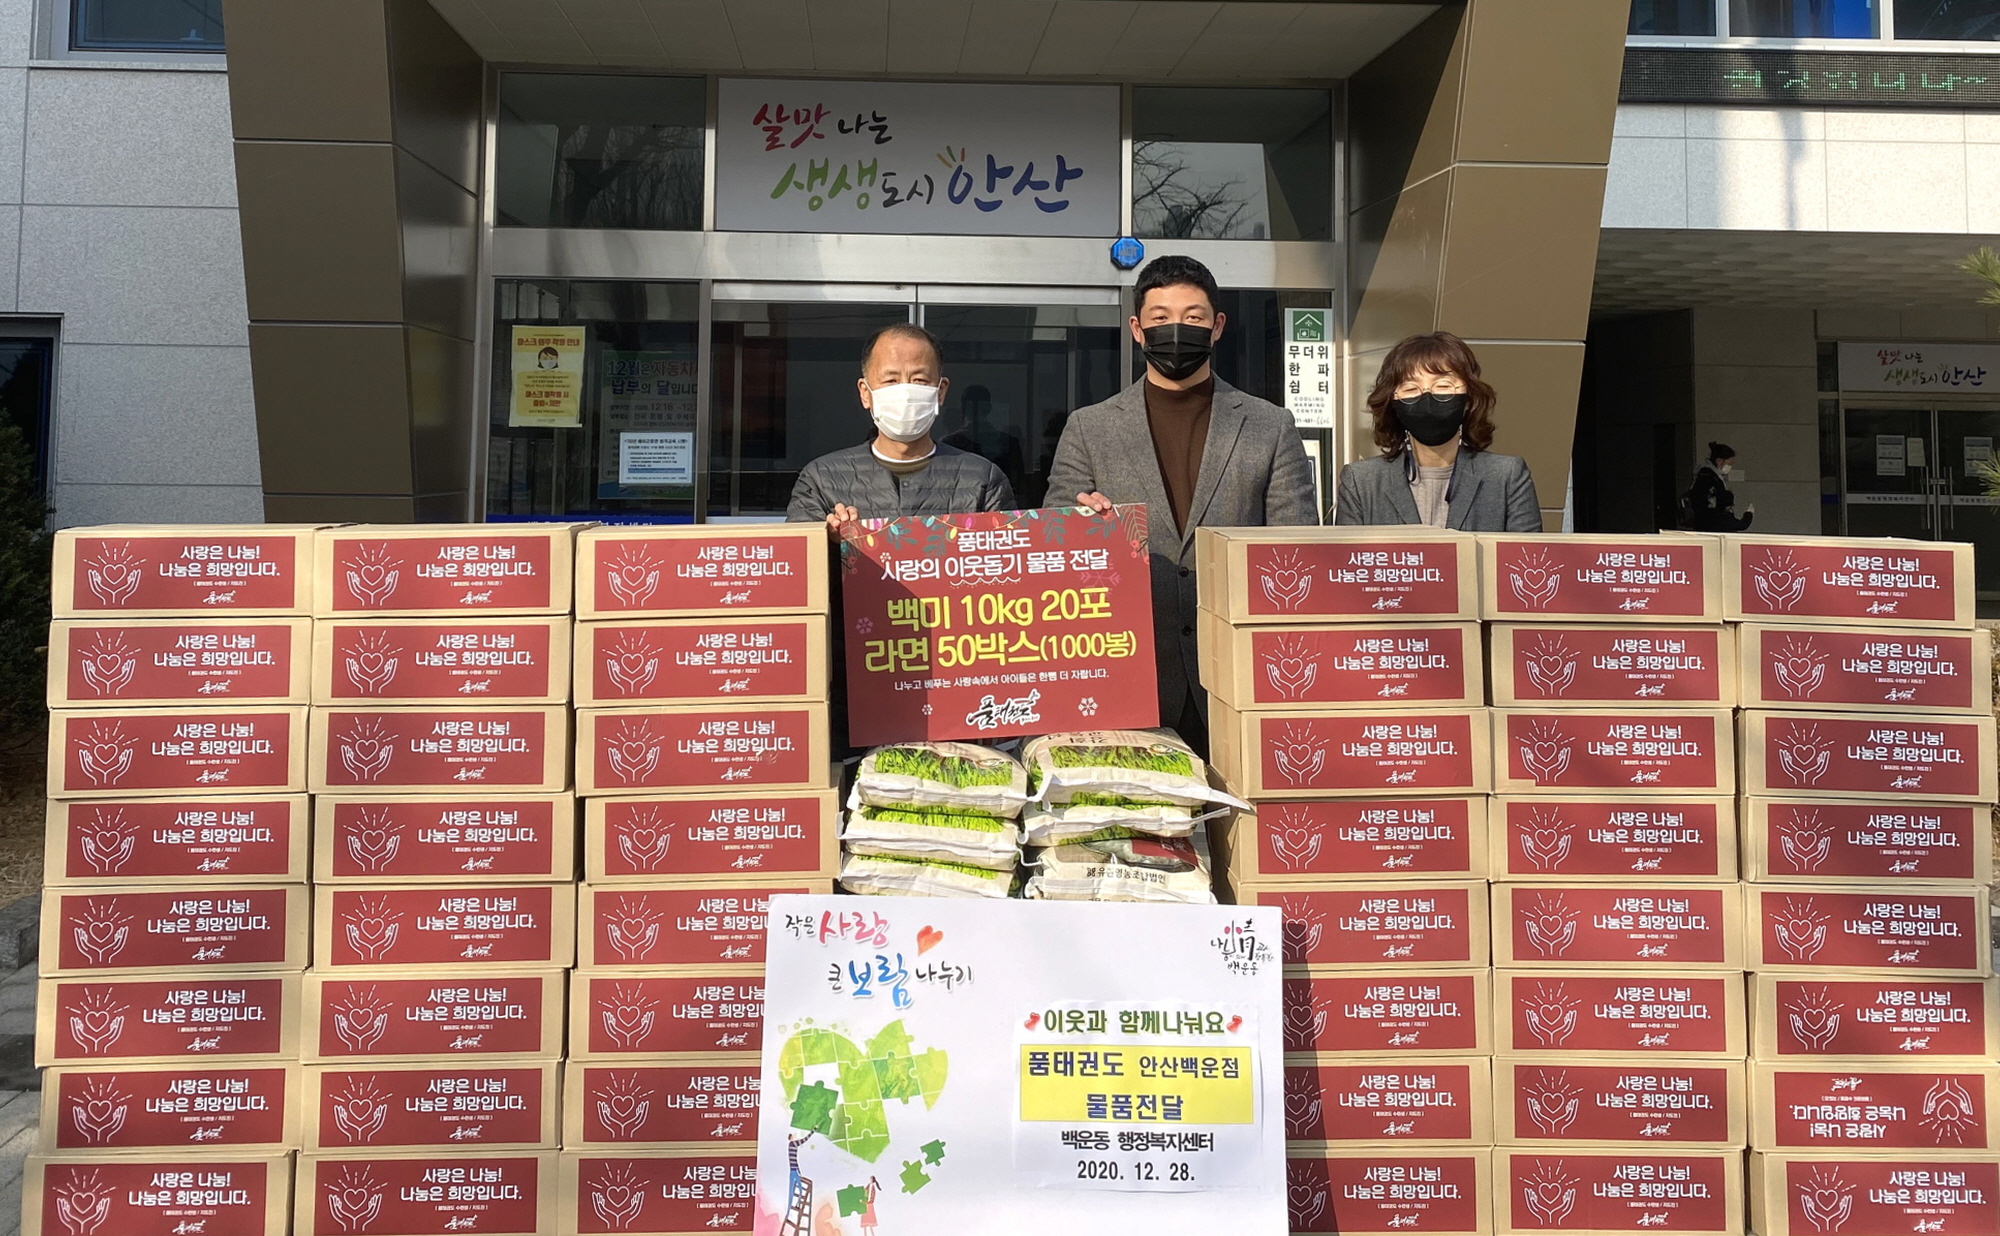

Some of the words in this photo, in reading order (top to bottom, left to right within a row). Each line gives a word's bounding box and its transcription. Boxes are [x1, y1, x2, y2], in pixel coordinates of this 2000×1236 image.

[752, 102, 831, 150] 살맛
[837, 110, 893, 145] 나는
[947, 154, 1084, 213] 안산
[517, 338, 538, 346] 마스크
[1289, 345, 1329, 359] 무더위
[653, 360, 698, 376] 자동차
[1942, 366, 1987, 386] 안산
[957, 529, 1032, 552] 품태권도
[181, 546, 223, 560] 사랑은
[228, 546, 260, 559] 나눔!
[697, 546, 738, 560] 사랑은
[743, 545, 773, 559] 나눔!
[1348, 552, 1388, 566] 사랑은
[1393, 552, 1423, 566] 나눔!
[160, 563, 201, 577] 나눔은
[206, 562, 280, 577] 희망입니다.
[677, 563, 718, 577] 나눔은
[722, 562, 793, 577] 희망입니다.
[880, 557, 941, 583] 사랑의
[944, 553, 1022, 578] 이웃돕기
[1026, 551, 1066, 574] 물품
[1069, 548, 1109, 572] 전달
[1329, 569, 1369, 583] 나눔은
[1374, 569, 1444, 582] 희망입니다.
[886, 595, 951, 632] 백미
[960, 592, 1034, 628] 10kg
[1041, 587, 1112, 621] 20포
[436, 634, 478, 649] 사랑은
[483, 634, 514, 648] 나눔!
[1612, 639, 1651, 653] 사랑은
[1656, 640, 1685, 653] 나눔!
[416, 652, 457, 666] 나눔은
[461, 651, 534, 666] 희망입니다.
[864, 636, 930, 673] 라면
[1862, 643, 1903, 657] 사랑은
[1907, 644, 1938, 658] 나눔!
[1593, 656, 1632, 669] 나눔은
[1637, 656, 1705, 670] 희망입니다.
[1843, 659, 1882, 673] 나눔은
[1887, 660, 1957, 676] 희망입니다.
[894, 679, 922, 692] 나누고
[924, 677, 951, 690] 베푸는
[953, 674, 999, 689] 사랑속에서
[1001, 672, 1037, 685] 아이들은
[1059, 670, 1069, 681] 더
[1362, 725, 1402, 739] 사랑은
[1407, 724, 1437, 739] 나눔!
[1343, 742, 1383, 757] 나눔은
[1387, 741, 1457, 756] 희망입니다.
[175, 811, 217, 826] 사랑은
[222, 811, 254, 825] 나눔!
[708, 808, 750, 823] 사랑은
[754, 808, 785, 822] 나눔!
[154, 829, 195, 843] 나눔은
[200, 828, 274, 843] 희망입니다.
[688, 826, 729, 841] 나눔은
[734, 825, 805, 840] 희망입니다.
[438, 898, 480, 913] 사랑은
[485, 897, 516, 912] 나눔!
[1359, 899, 1399, 913] 사랑은
[1404, 898, 1434, 912] 나눔!
[1613, 898, 1654, 912] 사랑은
[1658, 899, 1689, 913] 나눔!
[1864, 903, 1905, 918] 사랑은
[1909, 905, 1940, 919] 나눔!
[417, 916, 459, 930] 나눔은
[463, 914, 536, 929] 희망입니다.
[784, 914, 815, 937] 작은
[819, 910, 891, 947] 사랑
[1340, 916, 1380, 931] 나눔은
[1385, 915, 1455, 930] 희망입니다.
[1594, 915, 1634, 929] 나눔은
[1638, 915, 1709, 930] 희망입니다.
[1844, 920, 1885, 934] 나눔은
[1889, 921, 1961, 936] 희망입니다.
[826, 962, 844, 993] 큰
[849, 952, 914, 1008] 보람
[915, 963, 975, 993] 나누기
[165, 990, 208, 1005] 사랑은
[213, 990, 245, 1004] 나눔!
[143, 1008, 186, 1023] 나눔은
[191, 1007, 266, 1022] 희망입니다.
[1044, 1009, 1108, 1034] 이웃과
[1119, 1009, 1226, 1034] 함께나눠요
[1028, 1051, 1123, 1077] 품태권도
[1139, 1055, 1240, 1079] 안산백운점
[427, 1079, 469, 1093] 사랑은
[475, 1078, 506, 1092] 나눔!
[687, 1076, 729, 1091] 사랑은
[735, 1075, 760, 1091] 나눔
[406, 1097, 448, 1112] 나눔은
[453, 1096, 526, 1111] 희망입니다.
[667, 1094, 709, 1110] 나눔은
[713, 1093, 760, 1109] 희망입
[1086, 1094, 1184, 1120] 물품전달
[1866, 1106, 1906, 1121] 나눔은
[1809, 1123, 1842, 1139] 나눔!
[1846, 1123, 1887, 1139] 사랑은
[1061, 1130, 1110, 1151] 백운동
[1118, 1130, 1214, 1152] 행정복지센터
[1077, 1161, 1124, 1181] 2020.
[1134, 1161, 1161, 1181] 12.
[1169, 1161, 1195, 1181] 28.
[1613, 1165, 1654, 1180] 사랑은
[1659, 1166, 1690, 1180] 나눔!
[150, 1173, 193, 1188] 사랑은
[198, 1172, 230, 1187] 나눔!
[129, 1191, 171, 1206] 나눔은
[176, 1190, 251, 1205] 희망입니다.
[1594, 1183, 1634, 1197] 나눔은
[1639, 1183, 1710, 1198] 희망입니다.
